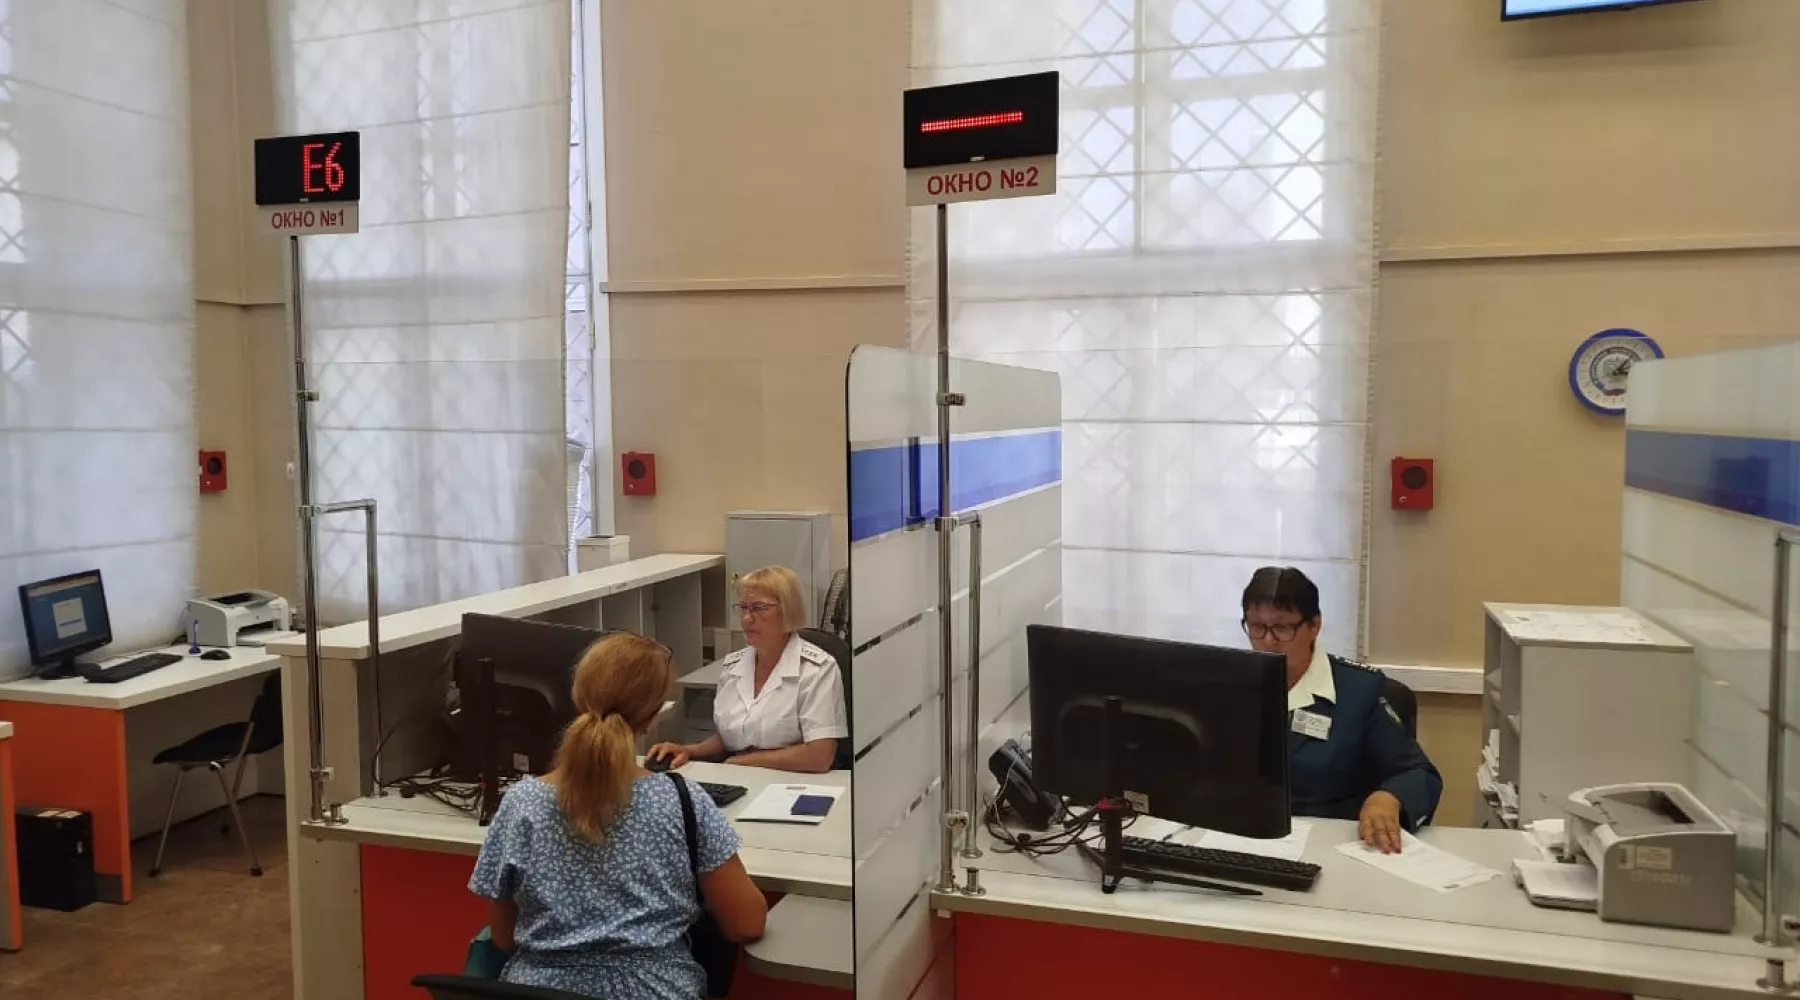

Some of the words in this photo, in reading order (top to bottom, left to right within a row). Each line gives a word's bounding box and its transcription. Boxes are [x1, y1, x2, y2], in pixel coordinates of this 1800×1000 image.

[303, 142, 344, 193] Е6
[927, 170, 992, 196] ОКНО
[1000, 166, 1039, 189] №2
[271, 210, 316, 229] ОКНО
[320, 209, 344, 227] №1
